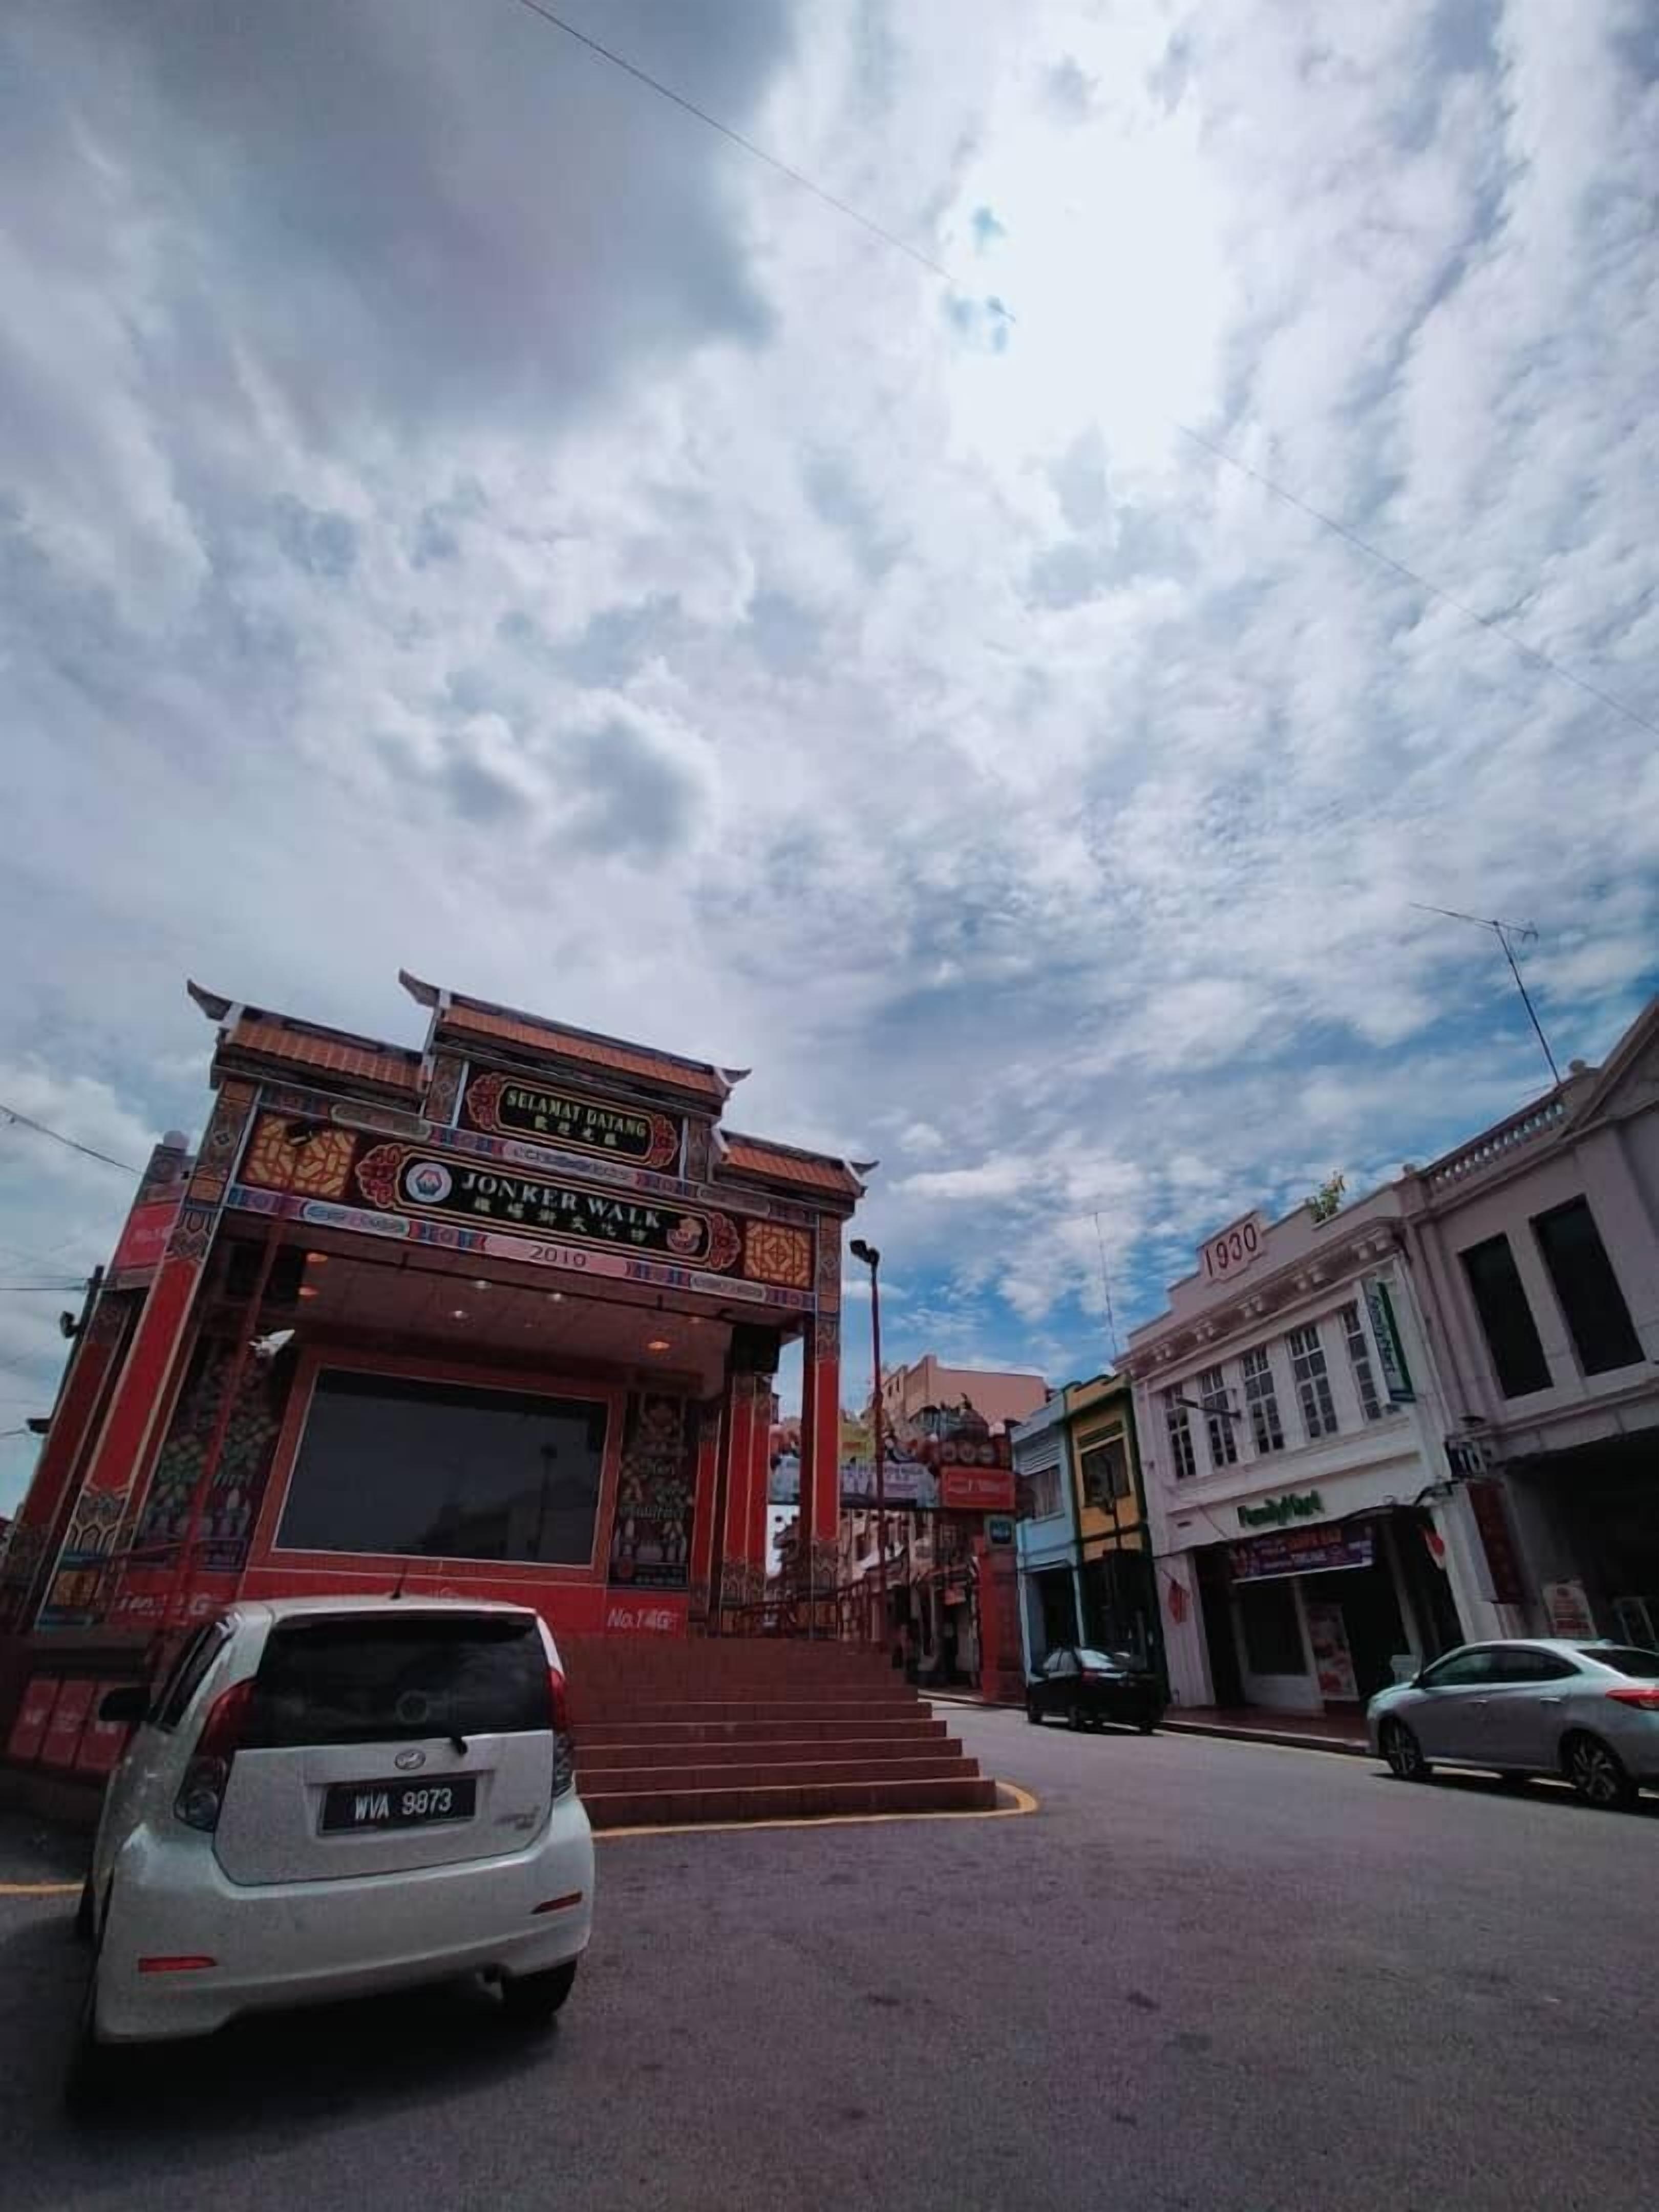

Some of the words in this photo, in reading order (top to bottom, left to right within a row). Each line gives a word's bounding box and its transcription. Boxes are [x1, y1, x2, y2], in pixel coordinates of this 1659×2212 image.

[506, 1089, 581, 1122] SELAMAT
[586, 1108, 646, 1138] DATANG
[459, 1172, 578, 1211] JONKER
[588, 1196, 660, 1229] WALK
[528, 1244, 586, 1268] 2010
[1206, 1223, 1257, 1278] 1930
[355, 1791, 390, 1821] WVA
[401, 1787, 453, 1815] 9873
